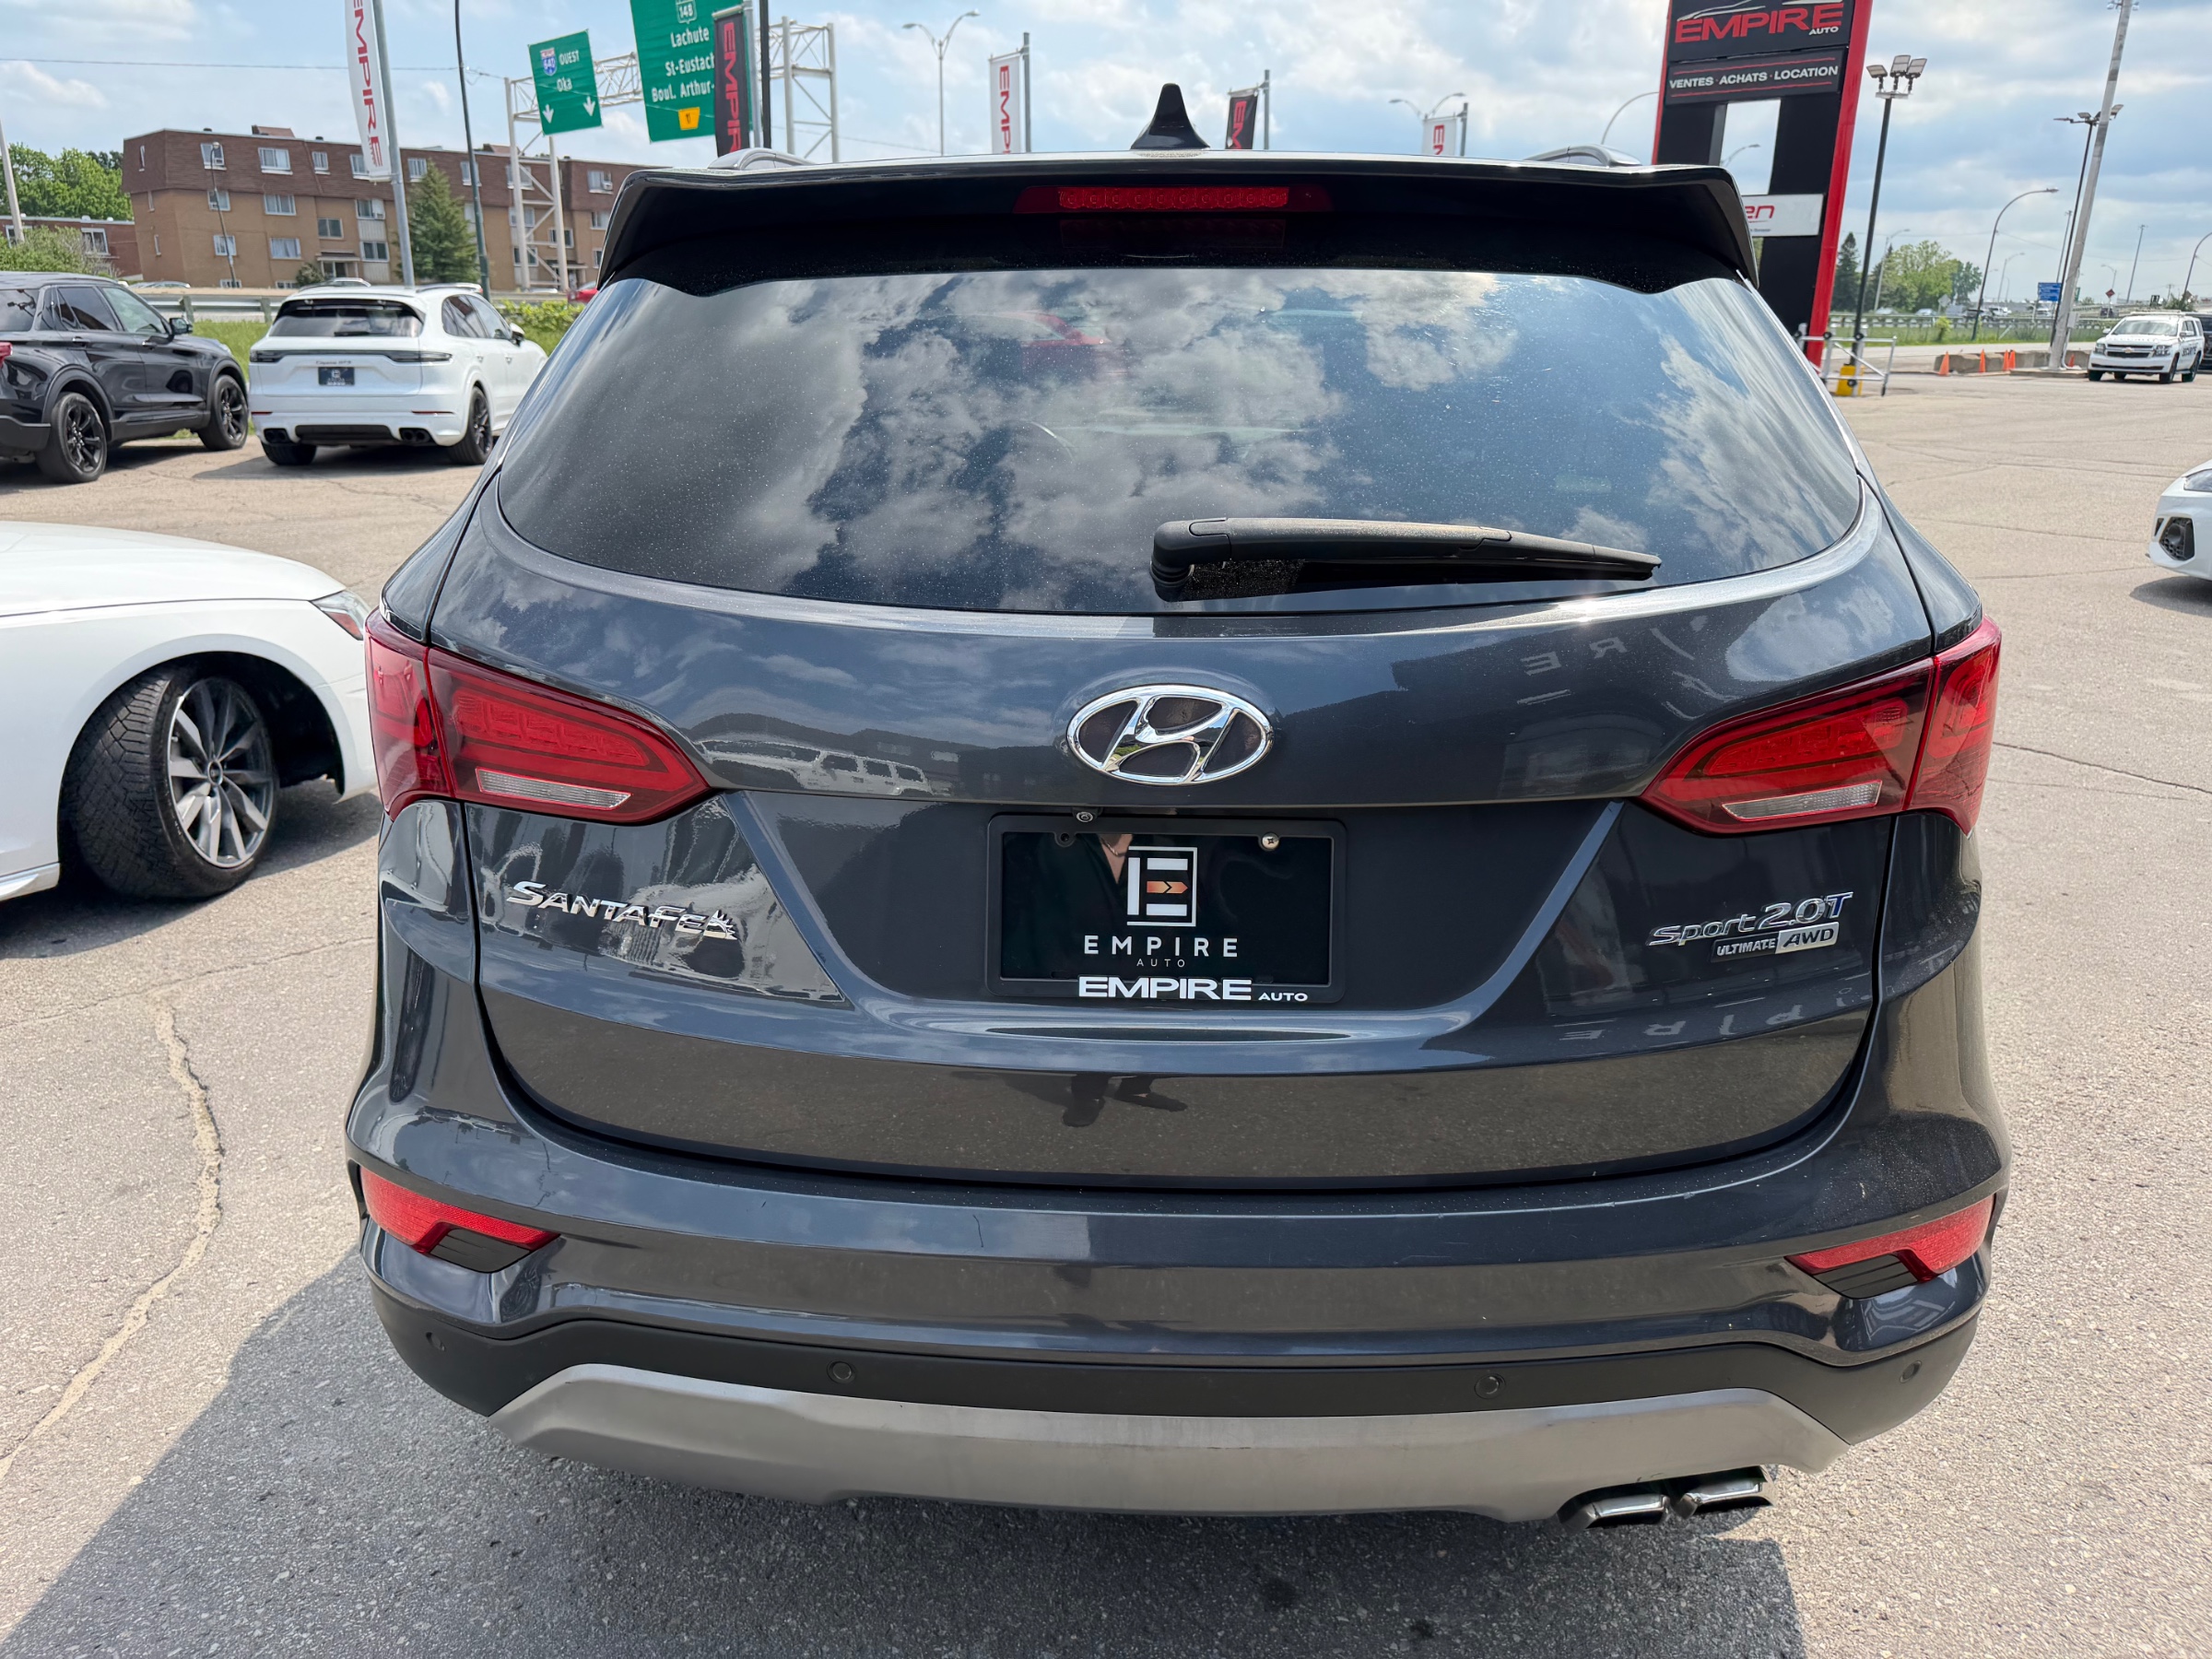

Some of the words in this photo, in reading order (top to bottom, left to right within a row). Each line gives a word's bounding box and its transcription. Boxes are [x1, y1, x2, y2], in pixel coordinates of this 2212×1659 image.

[1675, 3, 1843, 43] EMPIRE
[1808, 26, 1839, 35] AUTO
[670, 27, 710, 48] Lachute
[559, 50, 580, 65] OUEST
[354, 0, 383, 167] MPIRE
[556, 76, 572, 92] Oka
[1669, 76, 1713, 88] VENTES
[1719, 72, 1767, 85] ACHATS
[1774, 65, 1839, 80] LOCATION
[652, 84, 677, 102] Boul.
[1647, 913, 1757, 947] Sport
[1084, 935, 1238, 957] EMPIRE
[1716, 937, 1776, 956] ULTIMATE
[1783, 928, 1834, 948] AWD
[1136, 959, 1185, 968] AUTO
[1078, 976, 1252, 1001] EMPIRE
[1258, 992, 1308, 1002] AUTO
